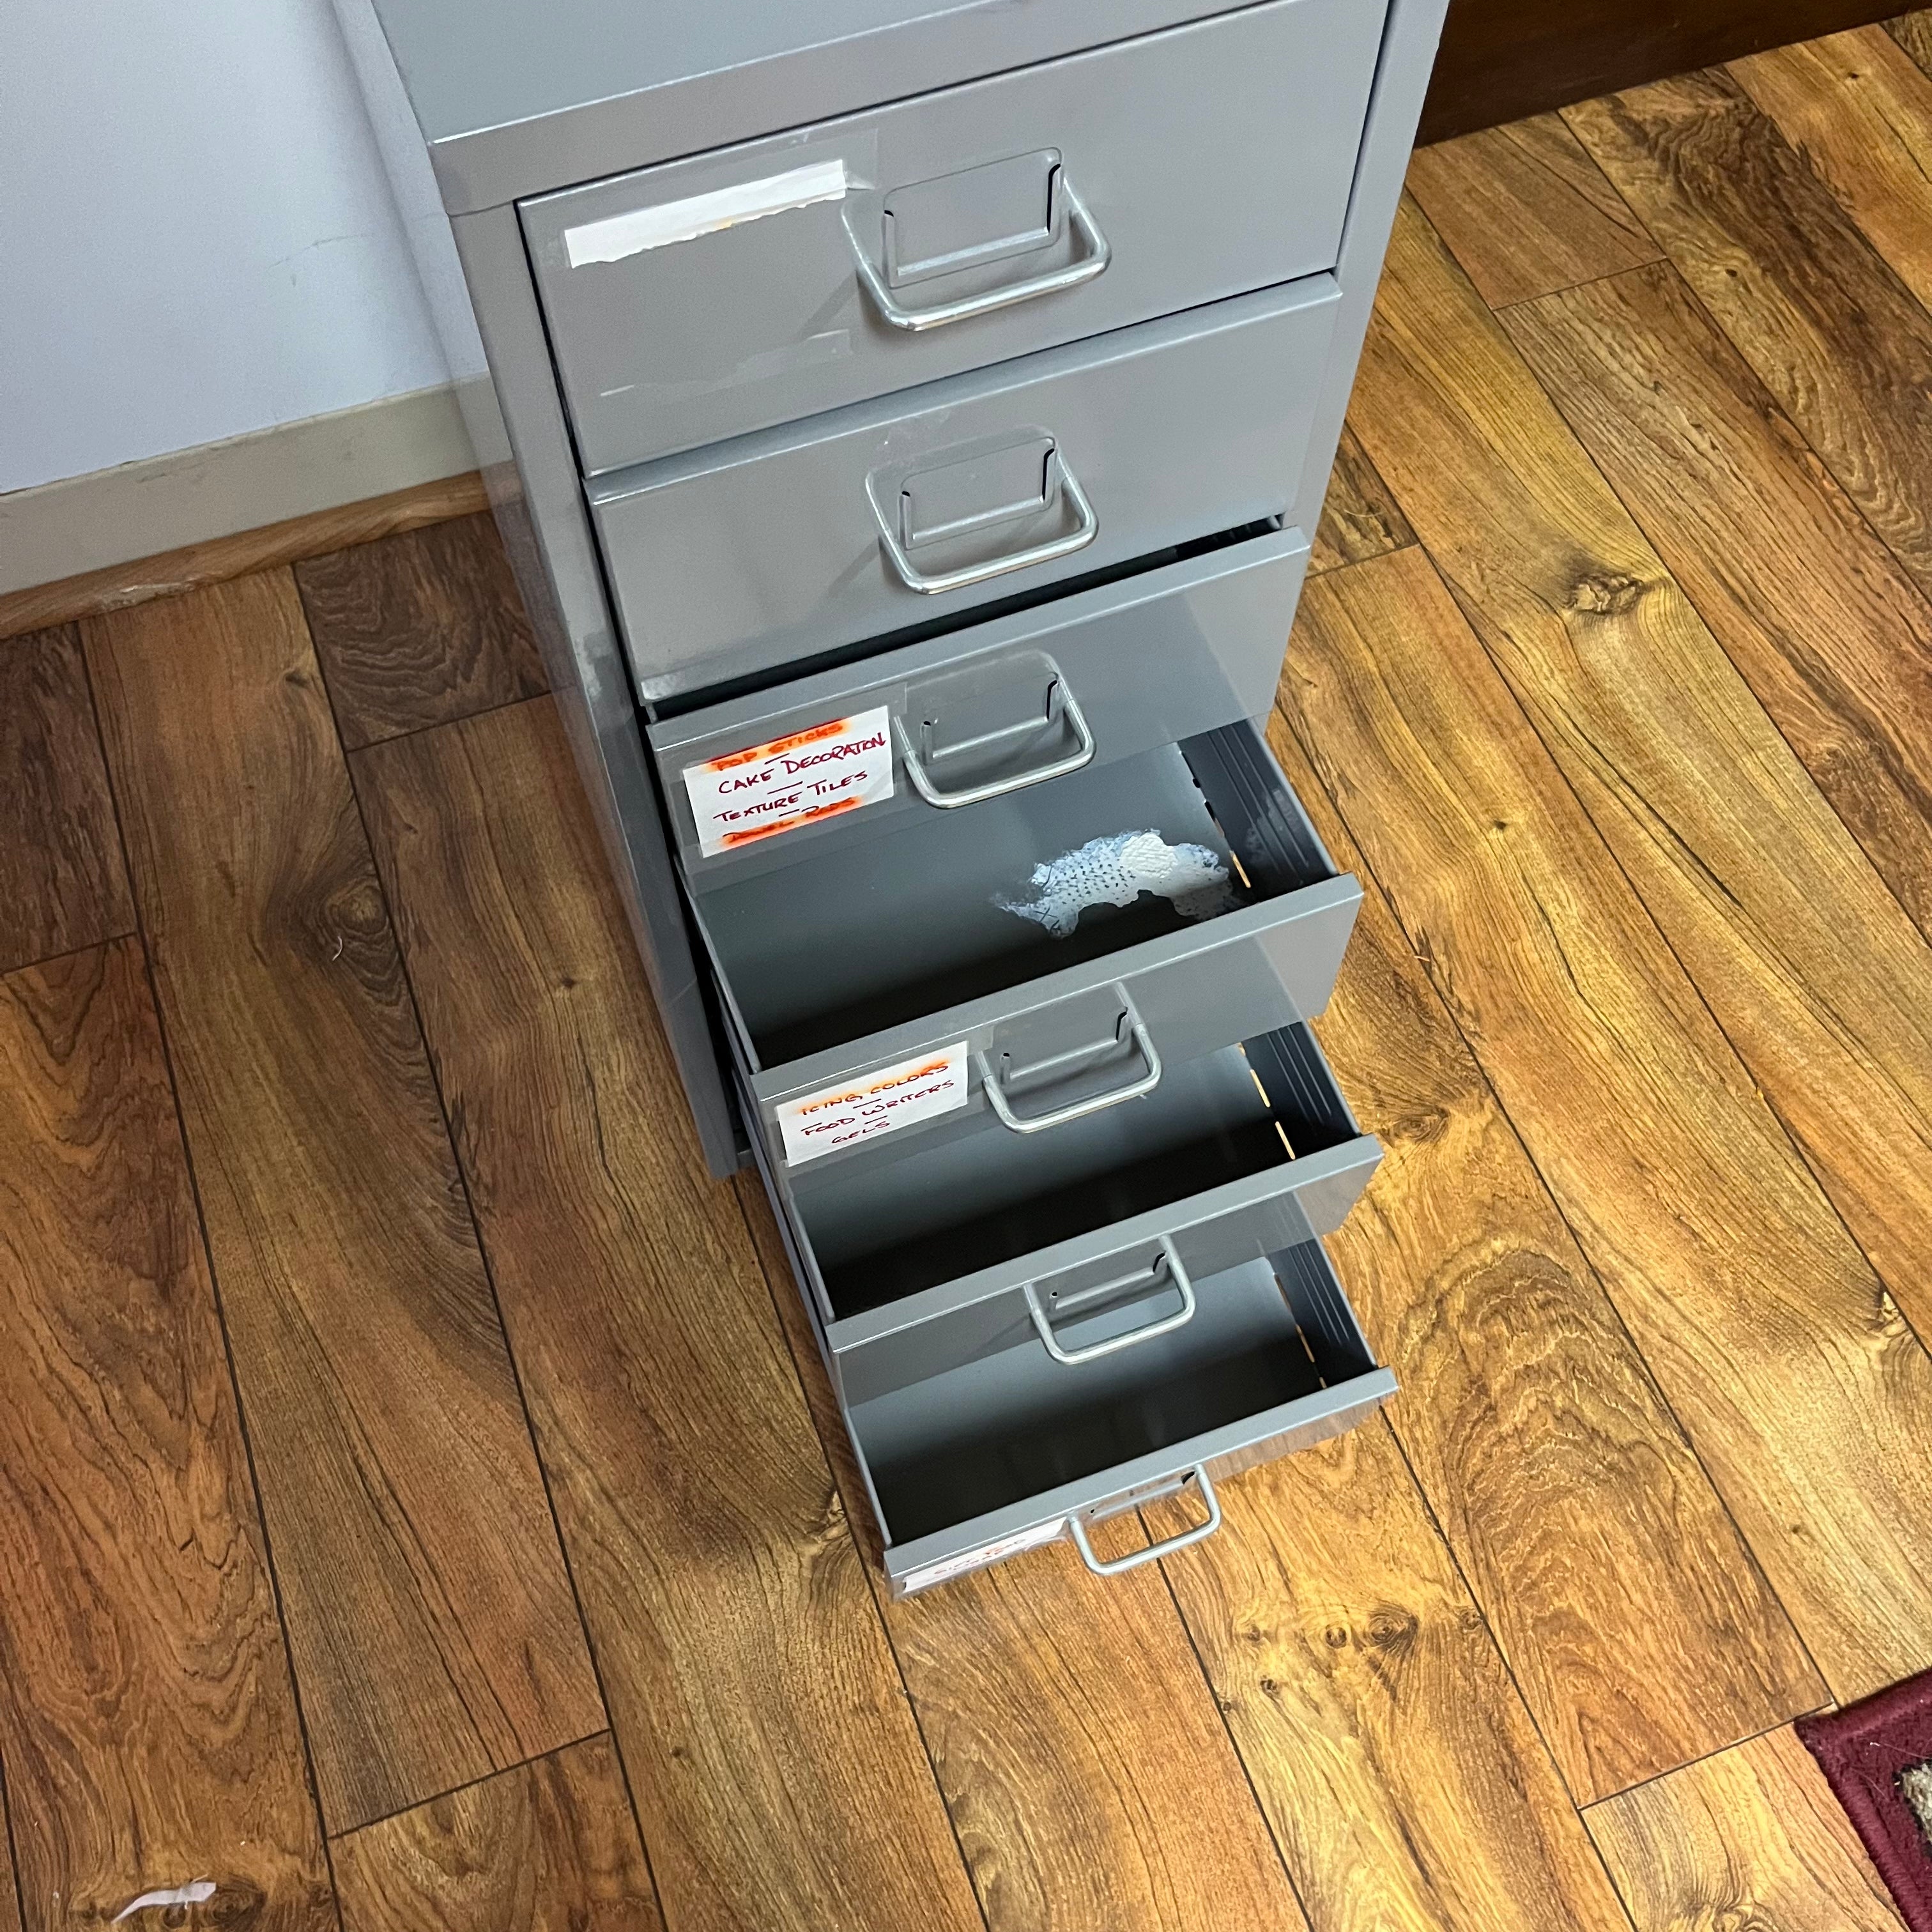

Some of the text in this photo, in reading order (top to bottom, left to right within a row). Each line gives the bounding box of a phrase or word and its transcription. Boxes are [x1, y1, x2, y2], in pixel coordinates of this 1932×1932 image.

[711, 723, 845, 771] POP STICKS
[718, 769, 774, 793] CAKE
[806, 770, 868, 795] TILES
[801, 1062, 949, 1116] ICING COLORS
[801, 1080, 954, 1136] FOOD WRITERS
[831, 1121, 891, 1144] GELS
